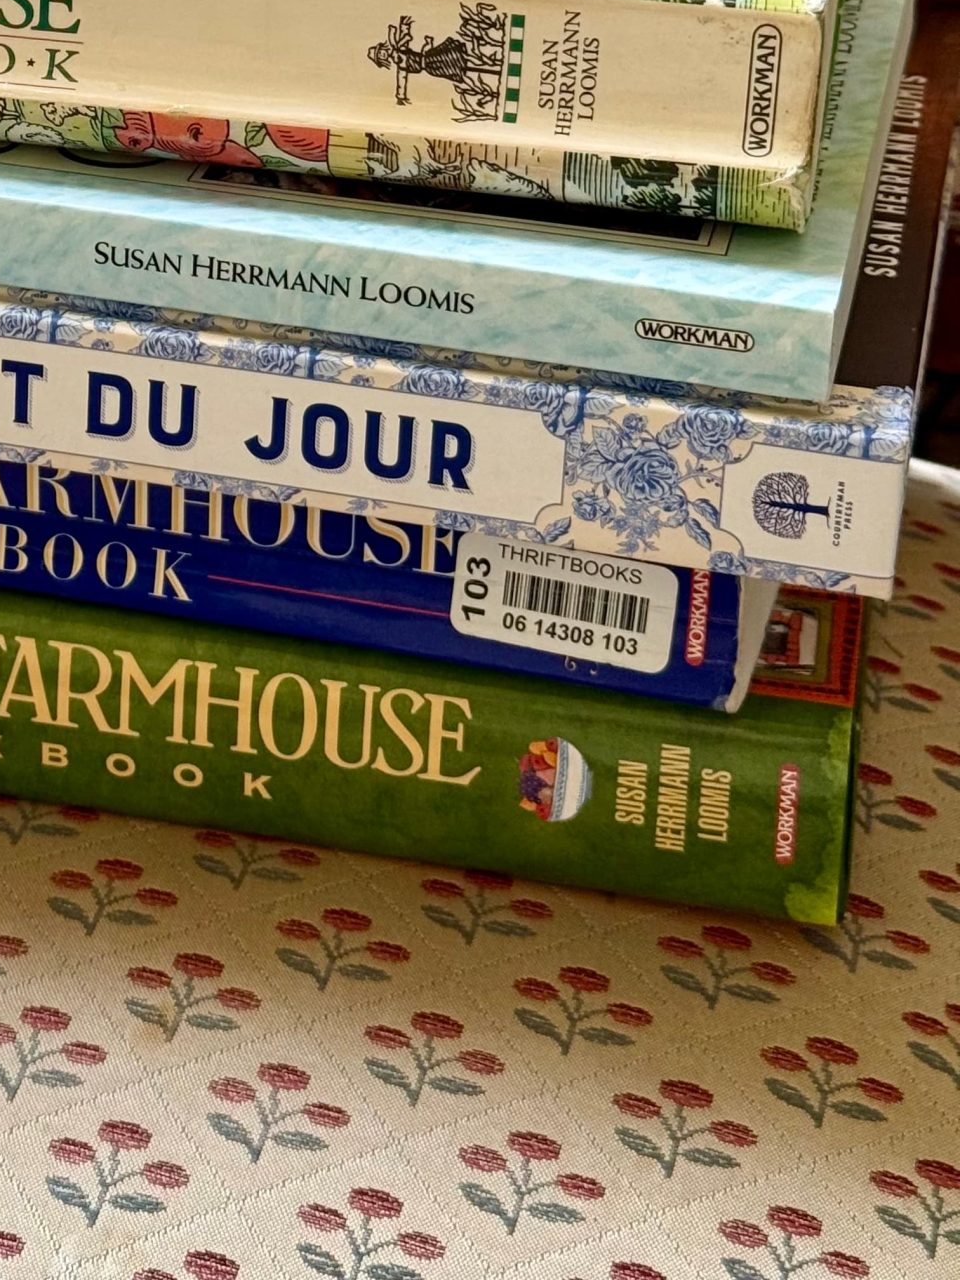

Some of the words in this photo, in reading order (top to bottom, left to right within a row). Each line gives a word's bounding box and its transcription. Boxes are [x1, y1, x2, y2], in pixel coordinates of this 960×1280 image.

[538, 39, 559, 110] SUSAN
[554, 10, 581, 136] HERRMANN
[577, 37, 600, 121] LOOMIS
[748, 33, 777, 150] WORKMAN
[893, 74, 928, 127] LOOMIS
[875, 130, 917, 216] HERRMANN
[94, 241, 183, 277] SUSAN
[190, 254, 351, 298] HERRMANN
[360, 277, 476, 315] LOOMIS
[864, 220, 904, 278] SUSAN
[641, 321, 749, 350] WORKMAN
[85, 370, 200, 450] DU
[244, 396, 475, 494] JOUR
[832, 481, 845, 546] COUNTRYMAN
[843, 501, 853, 529] PRESS
[461, 556, 491, 621] 103
[498, 543, 642, 585] THRIFTBOOKS
[502, 612, 527, 632] 06
[534, 619, 594, 646] 14308
[602, 633, 638, 656] 103
[688, 569, 710, 660] WORKMAN
[615, 759, 648, 825] SUSAN
[655, 743, 690, 852] HERRMANN
[697, 768, 732, 842] LOOMIS
[776, 770, 797, 858] WORKMAN
